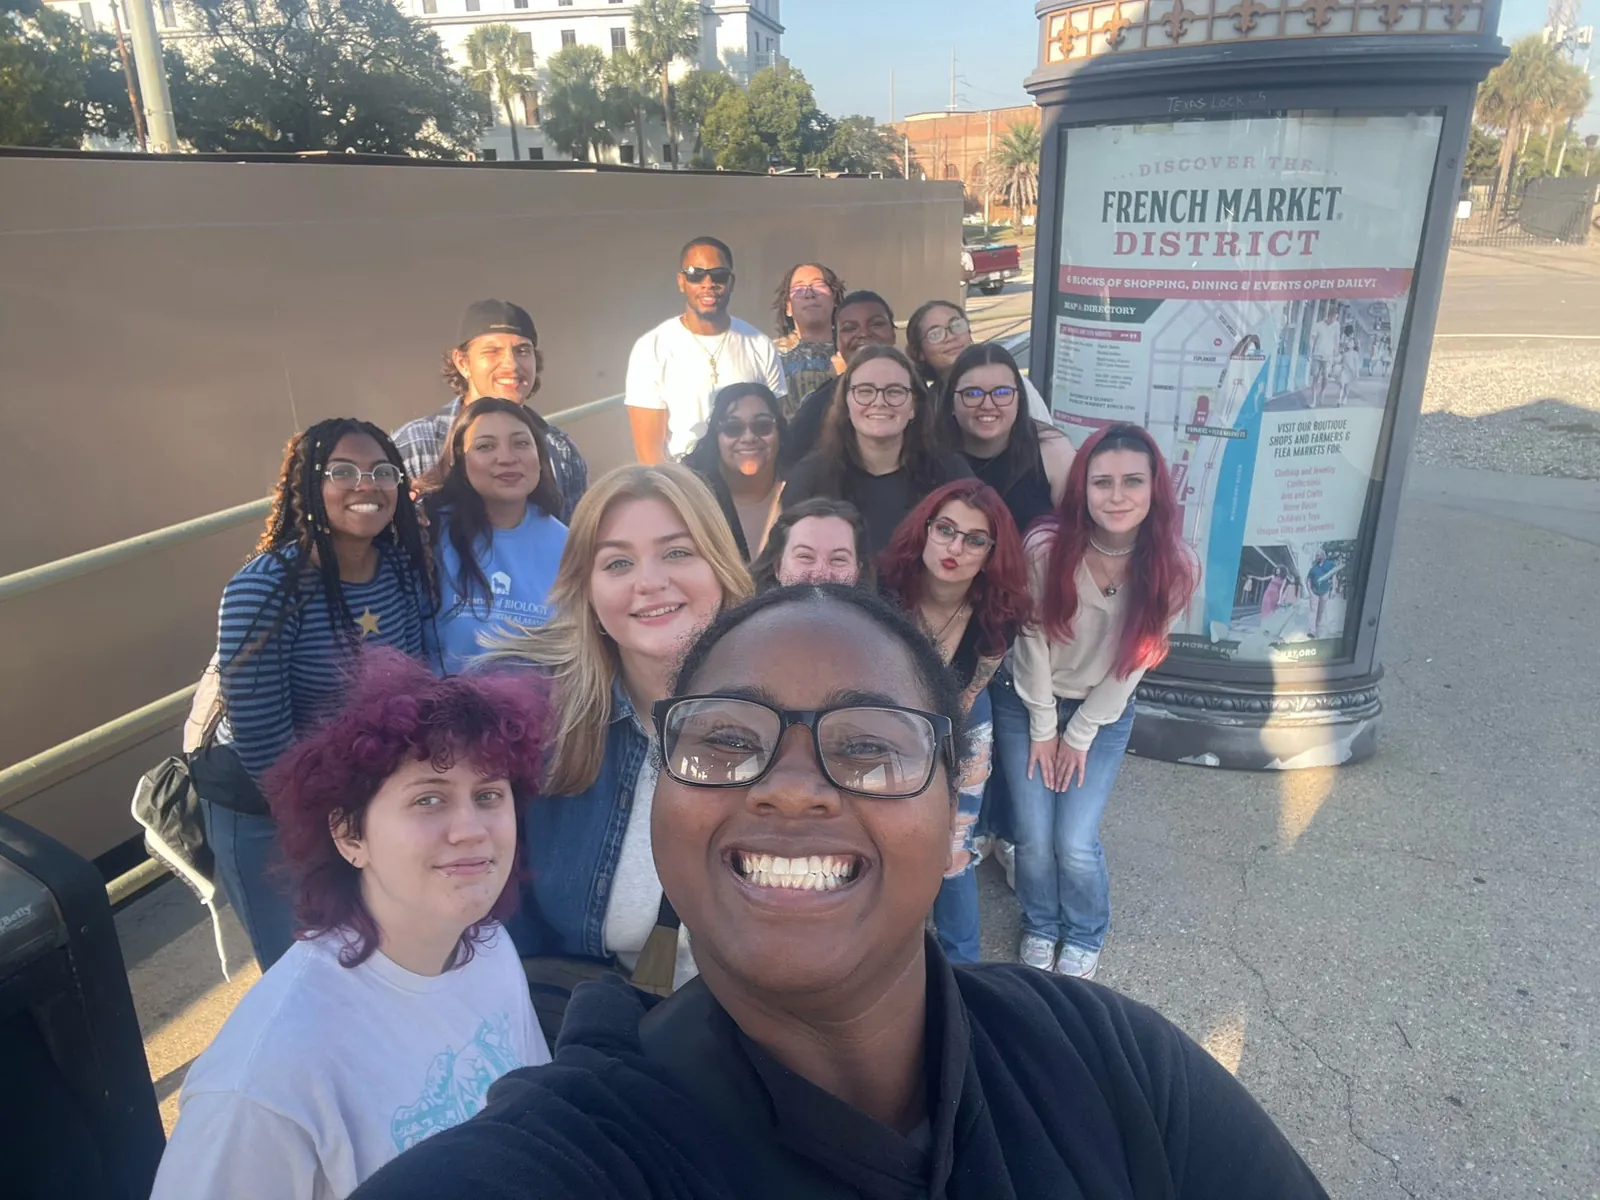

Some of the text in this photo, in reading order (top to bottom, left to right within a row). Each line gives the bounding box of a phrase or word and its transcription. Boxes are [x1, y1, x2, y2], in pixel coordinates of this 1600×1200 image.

[1140, 156, 1313, 178] DISCOVER THE
[1101, 186, 1342, 224] FRENCH MARKET
[1113, 230, 1321, 257] DISTRICT
[1066, 275, 1072, 284] 6
[1072, 275, 1106, 287] BLOCKS
[1107, 278, 1122, 288] OF
[1124, 278, 1190, 290] SHOPPING,
[1192, 280, 1238, 291] DINING
[1254, 280, 1301, 291] EVENTS
[1303, 279, 1334, 290] OPEN
[1064, 301, 1078, 311] MAP
[1083, 303, 1137, 316] DIRECTORY
[1277, 419, 1348, 434] VISIT OUR BOUTIQUE
[1269, 435, 1293, 447] SHOPS
[1294, 433, 1310, 445] AND
[1311, 431, 1344, 444] FARMERS
[1274, 447, 1291, 459] FLEA
[1293, 445, 1326, 457] MARKETS
